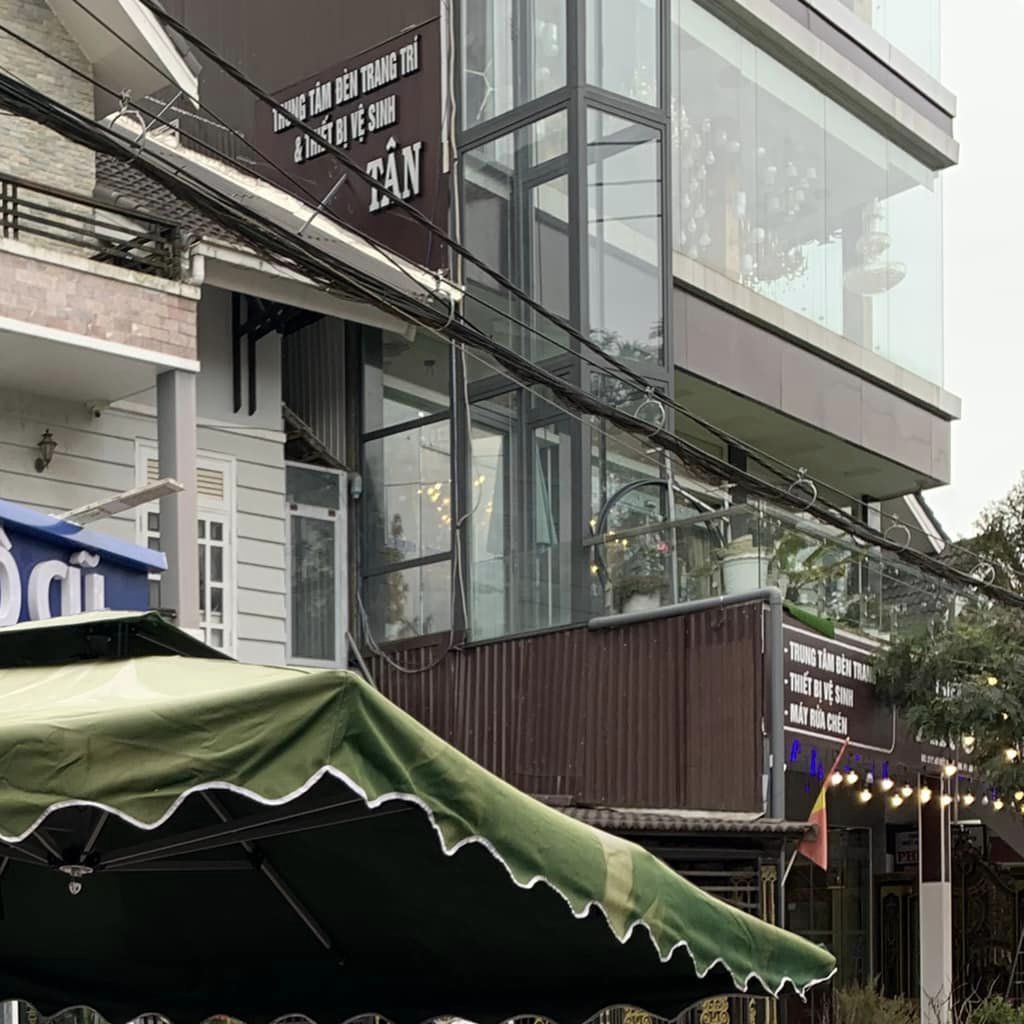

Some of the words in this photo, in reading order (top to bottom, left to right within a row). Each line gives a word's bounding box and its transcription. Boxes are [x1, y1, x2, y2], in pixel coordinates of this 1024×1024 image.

[361, 52, 397, 92] TRANG
[336, 116, 348, 148] BỊ
[350, 104, 366, 142] VỆ
[368, 95, 396, 131] SINH
[366, 137, 422, 213] TÂN
[834, 685, 854, 707] SINH
